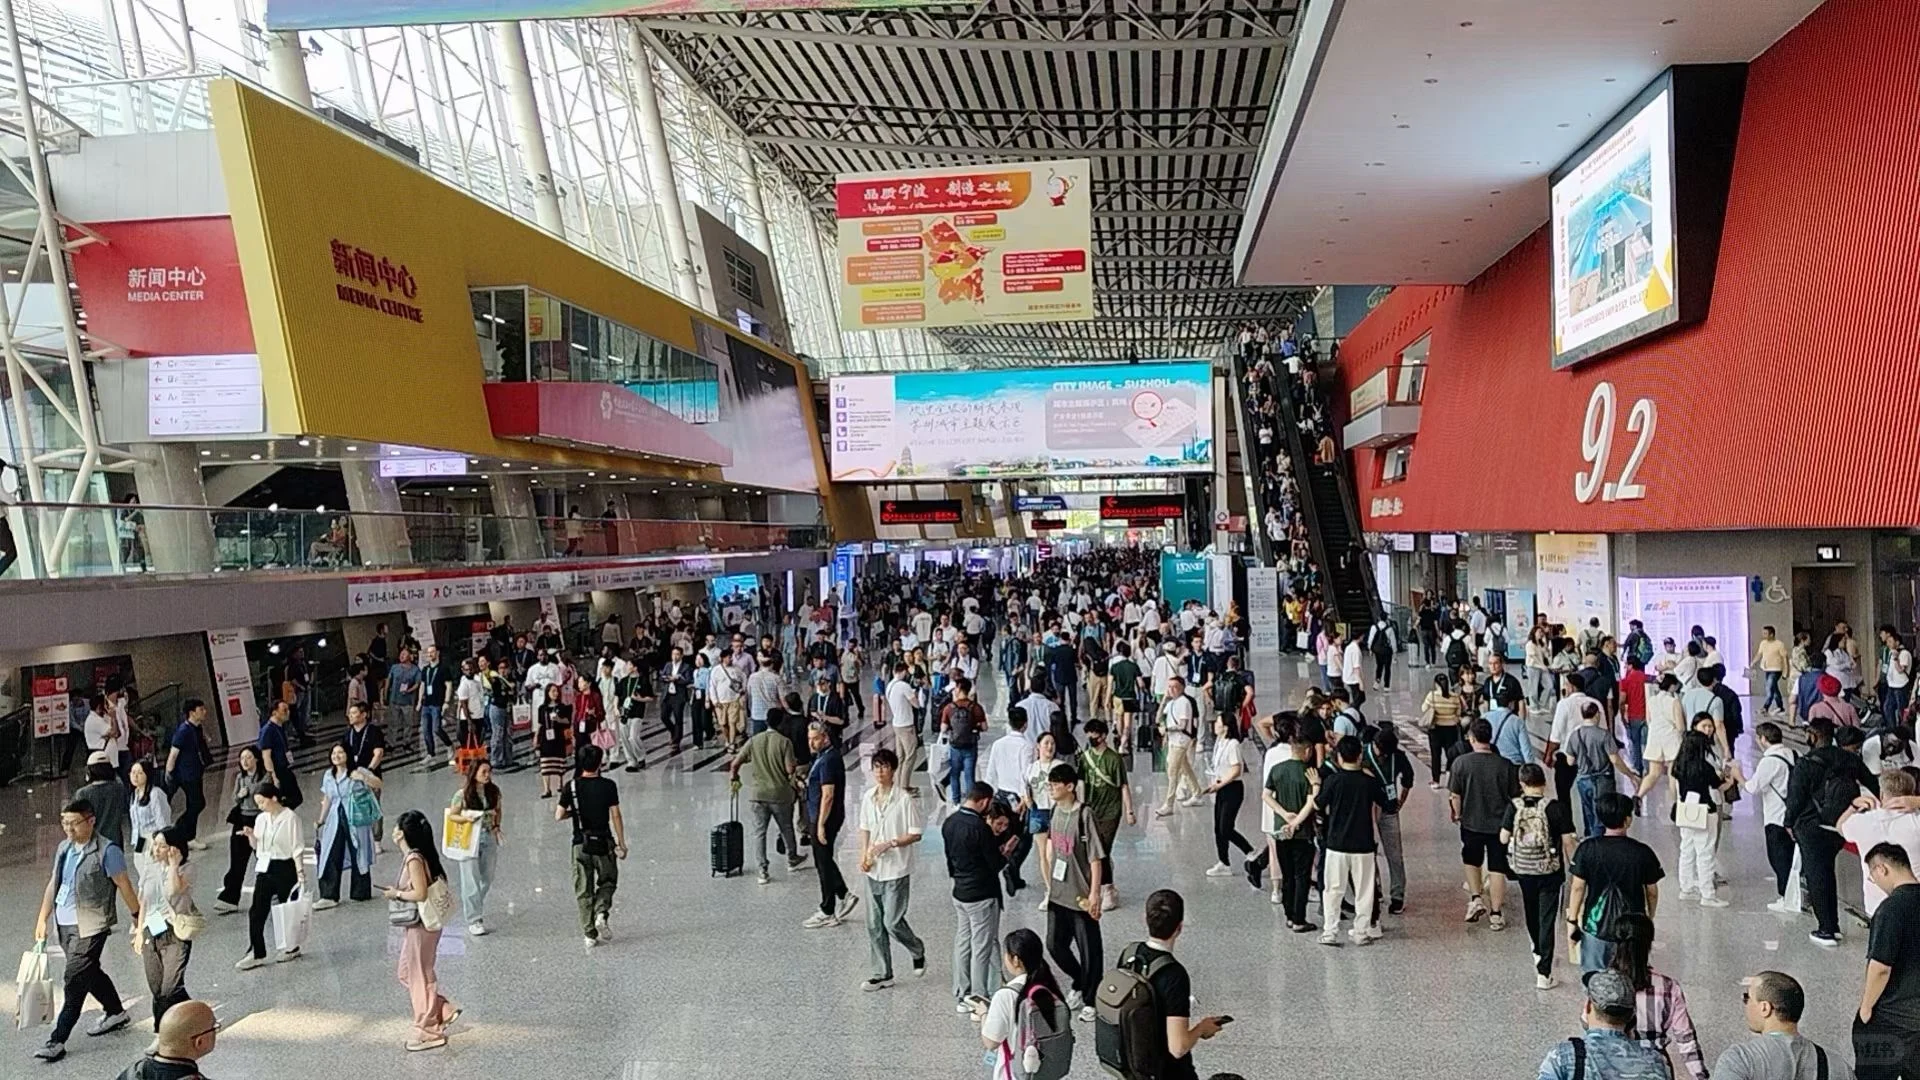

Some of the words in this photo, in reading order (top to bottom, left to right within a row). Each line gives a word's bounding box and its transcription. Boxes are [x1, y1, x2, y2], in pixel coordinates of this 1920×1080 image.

[128, 266, 207, 288] 新闻中心
[330, 238, 417, 299] 新闻中心
[128, 291, 160, 302] MEDIA
[161, 290, 204, 301] CENTER
[336, 284, 380, 311] MEDIA
[1053, 381, 1077, 392] CITY
[1077, 381, 1113, 391] IMAGE
[1124, 378, 1170, 390] SUZHOU
[1575, 382, 1658, 503] 9.2
